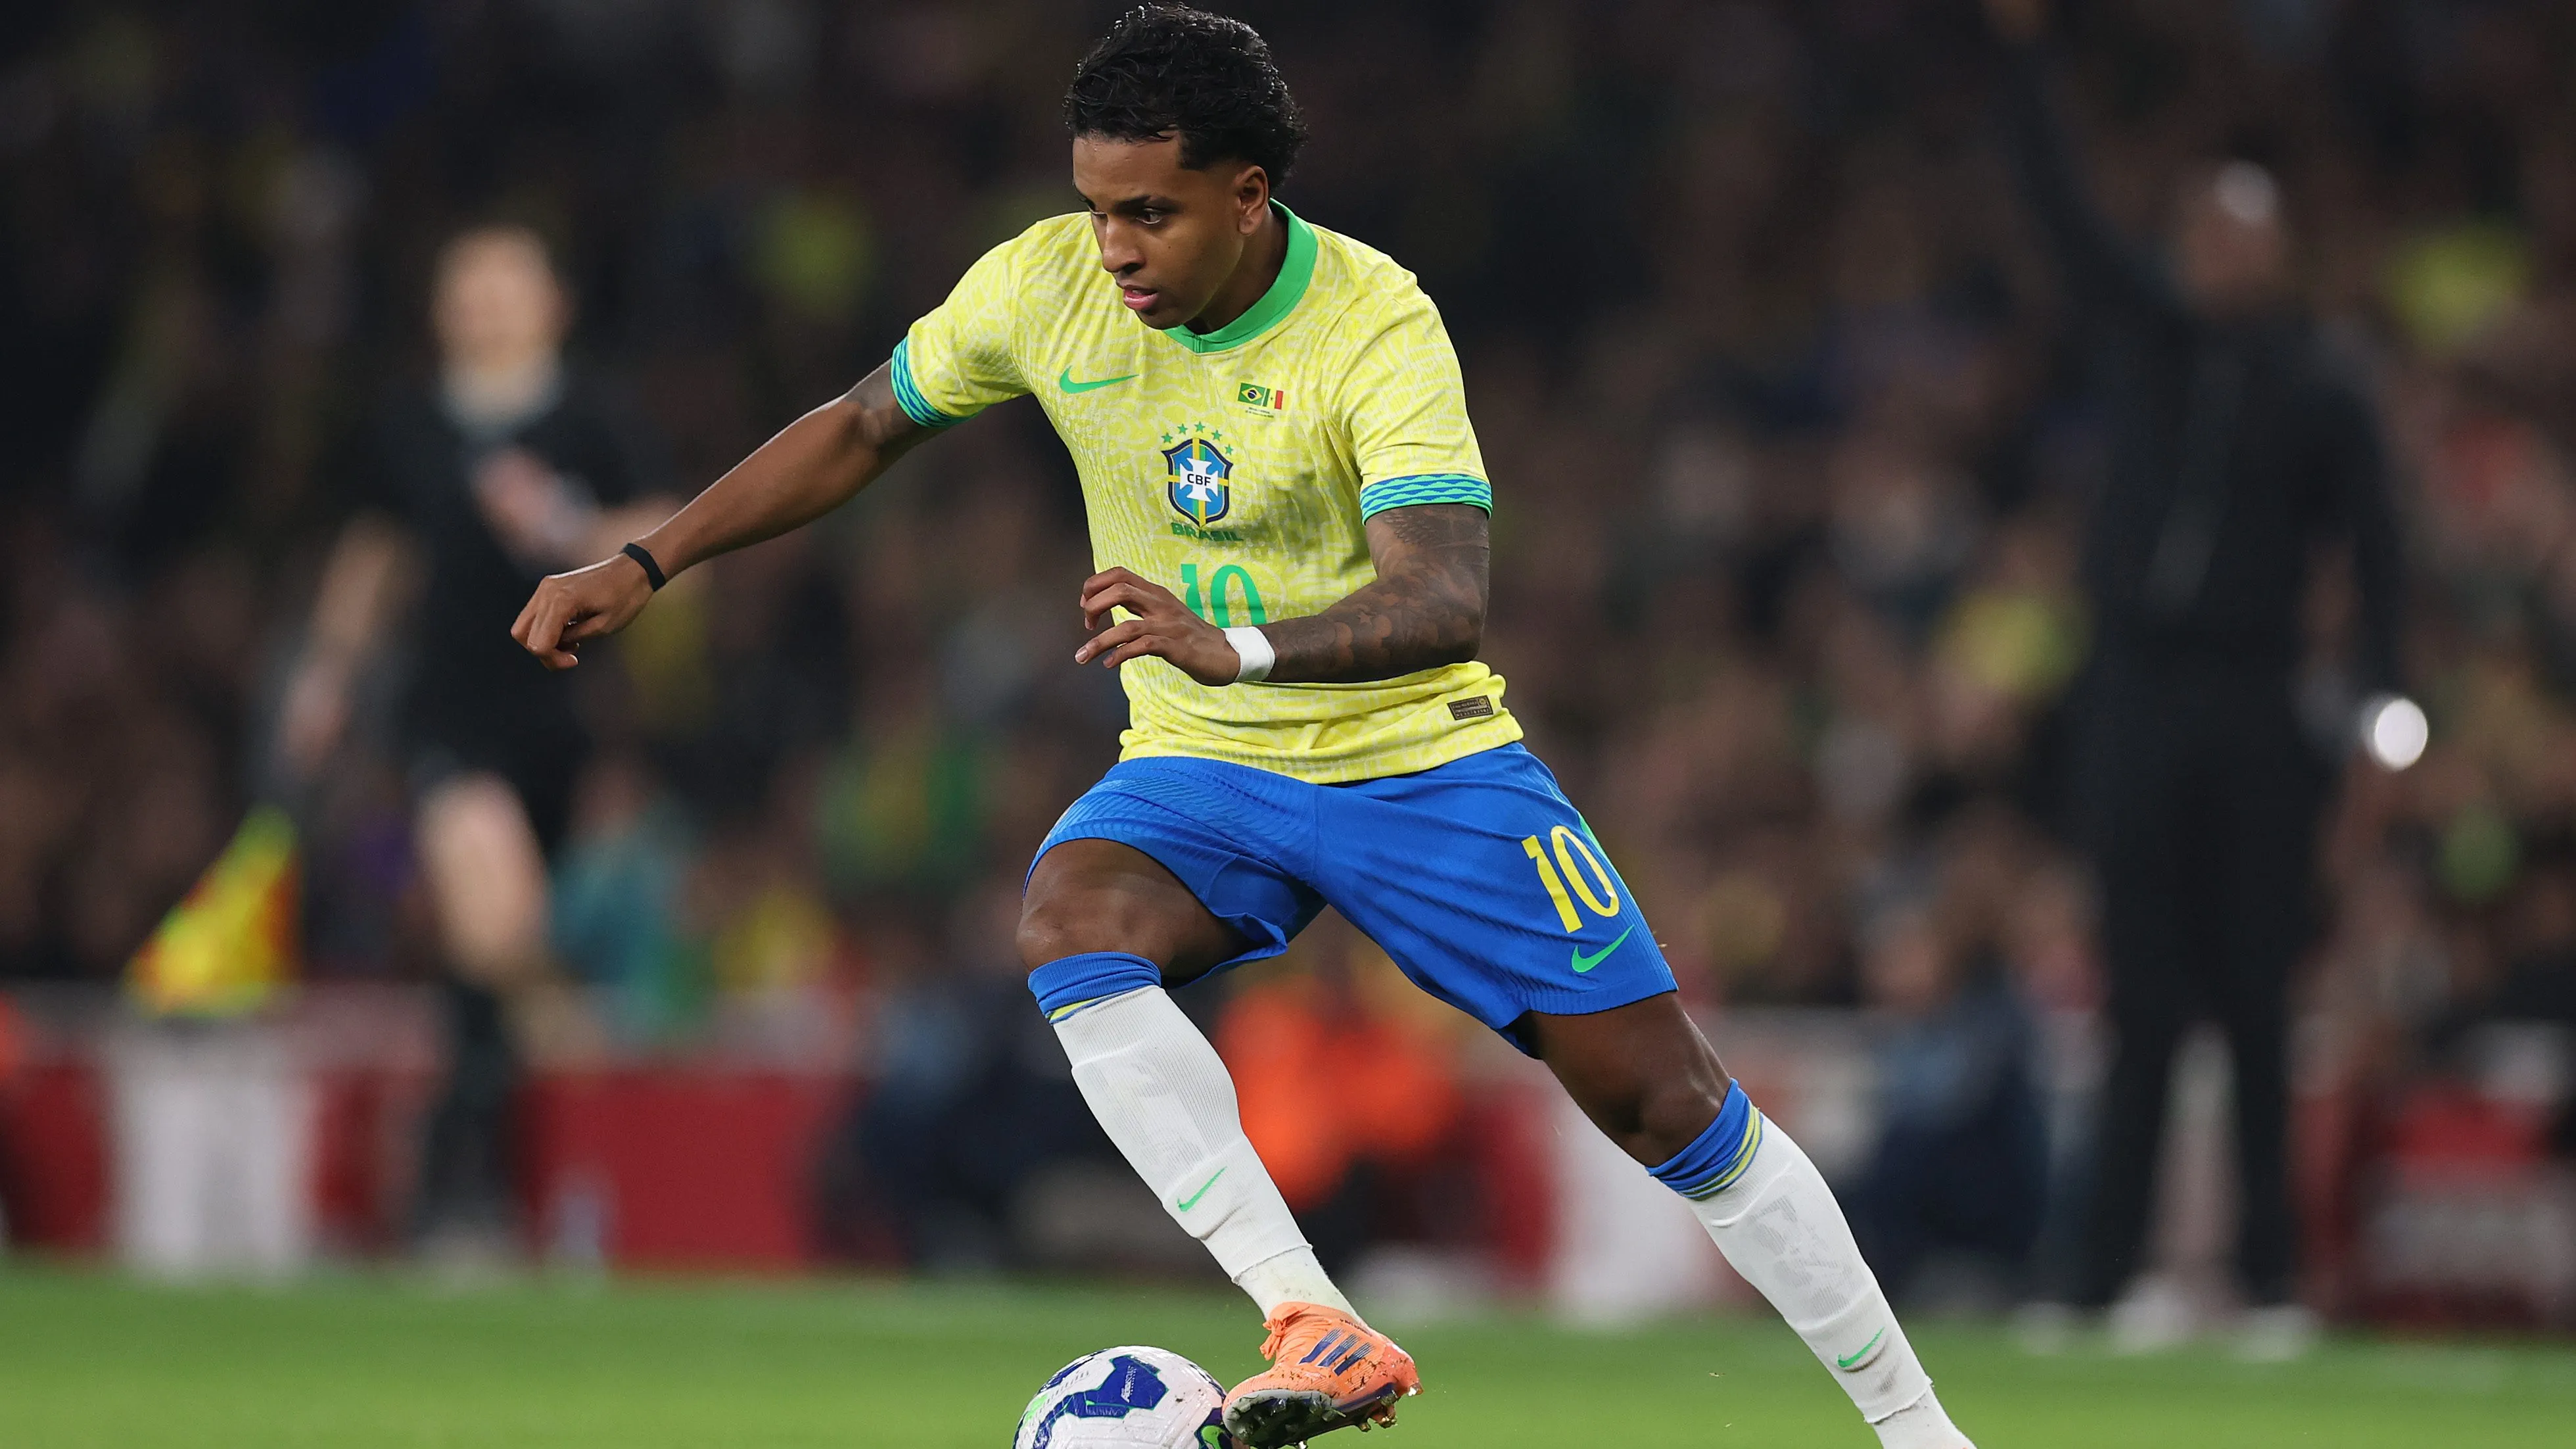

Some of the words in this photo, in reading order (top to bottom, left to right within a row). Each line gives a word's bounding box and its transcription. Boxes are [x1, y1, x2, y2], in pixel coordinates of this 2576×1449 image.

[1187, 473, 1211, 486] CBF
[1171, 522, 1244, 541] BRASIL
[1181, 563, 1267, 629] 10
[1521, 825, 1620, 934] 10
